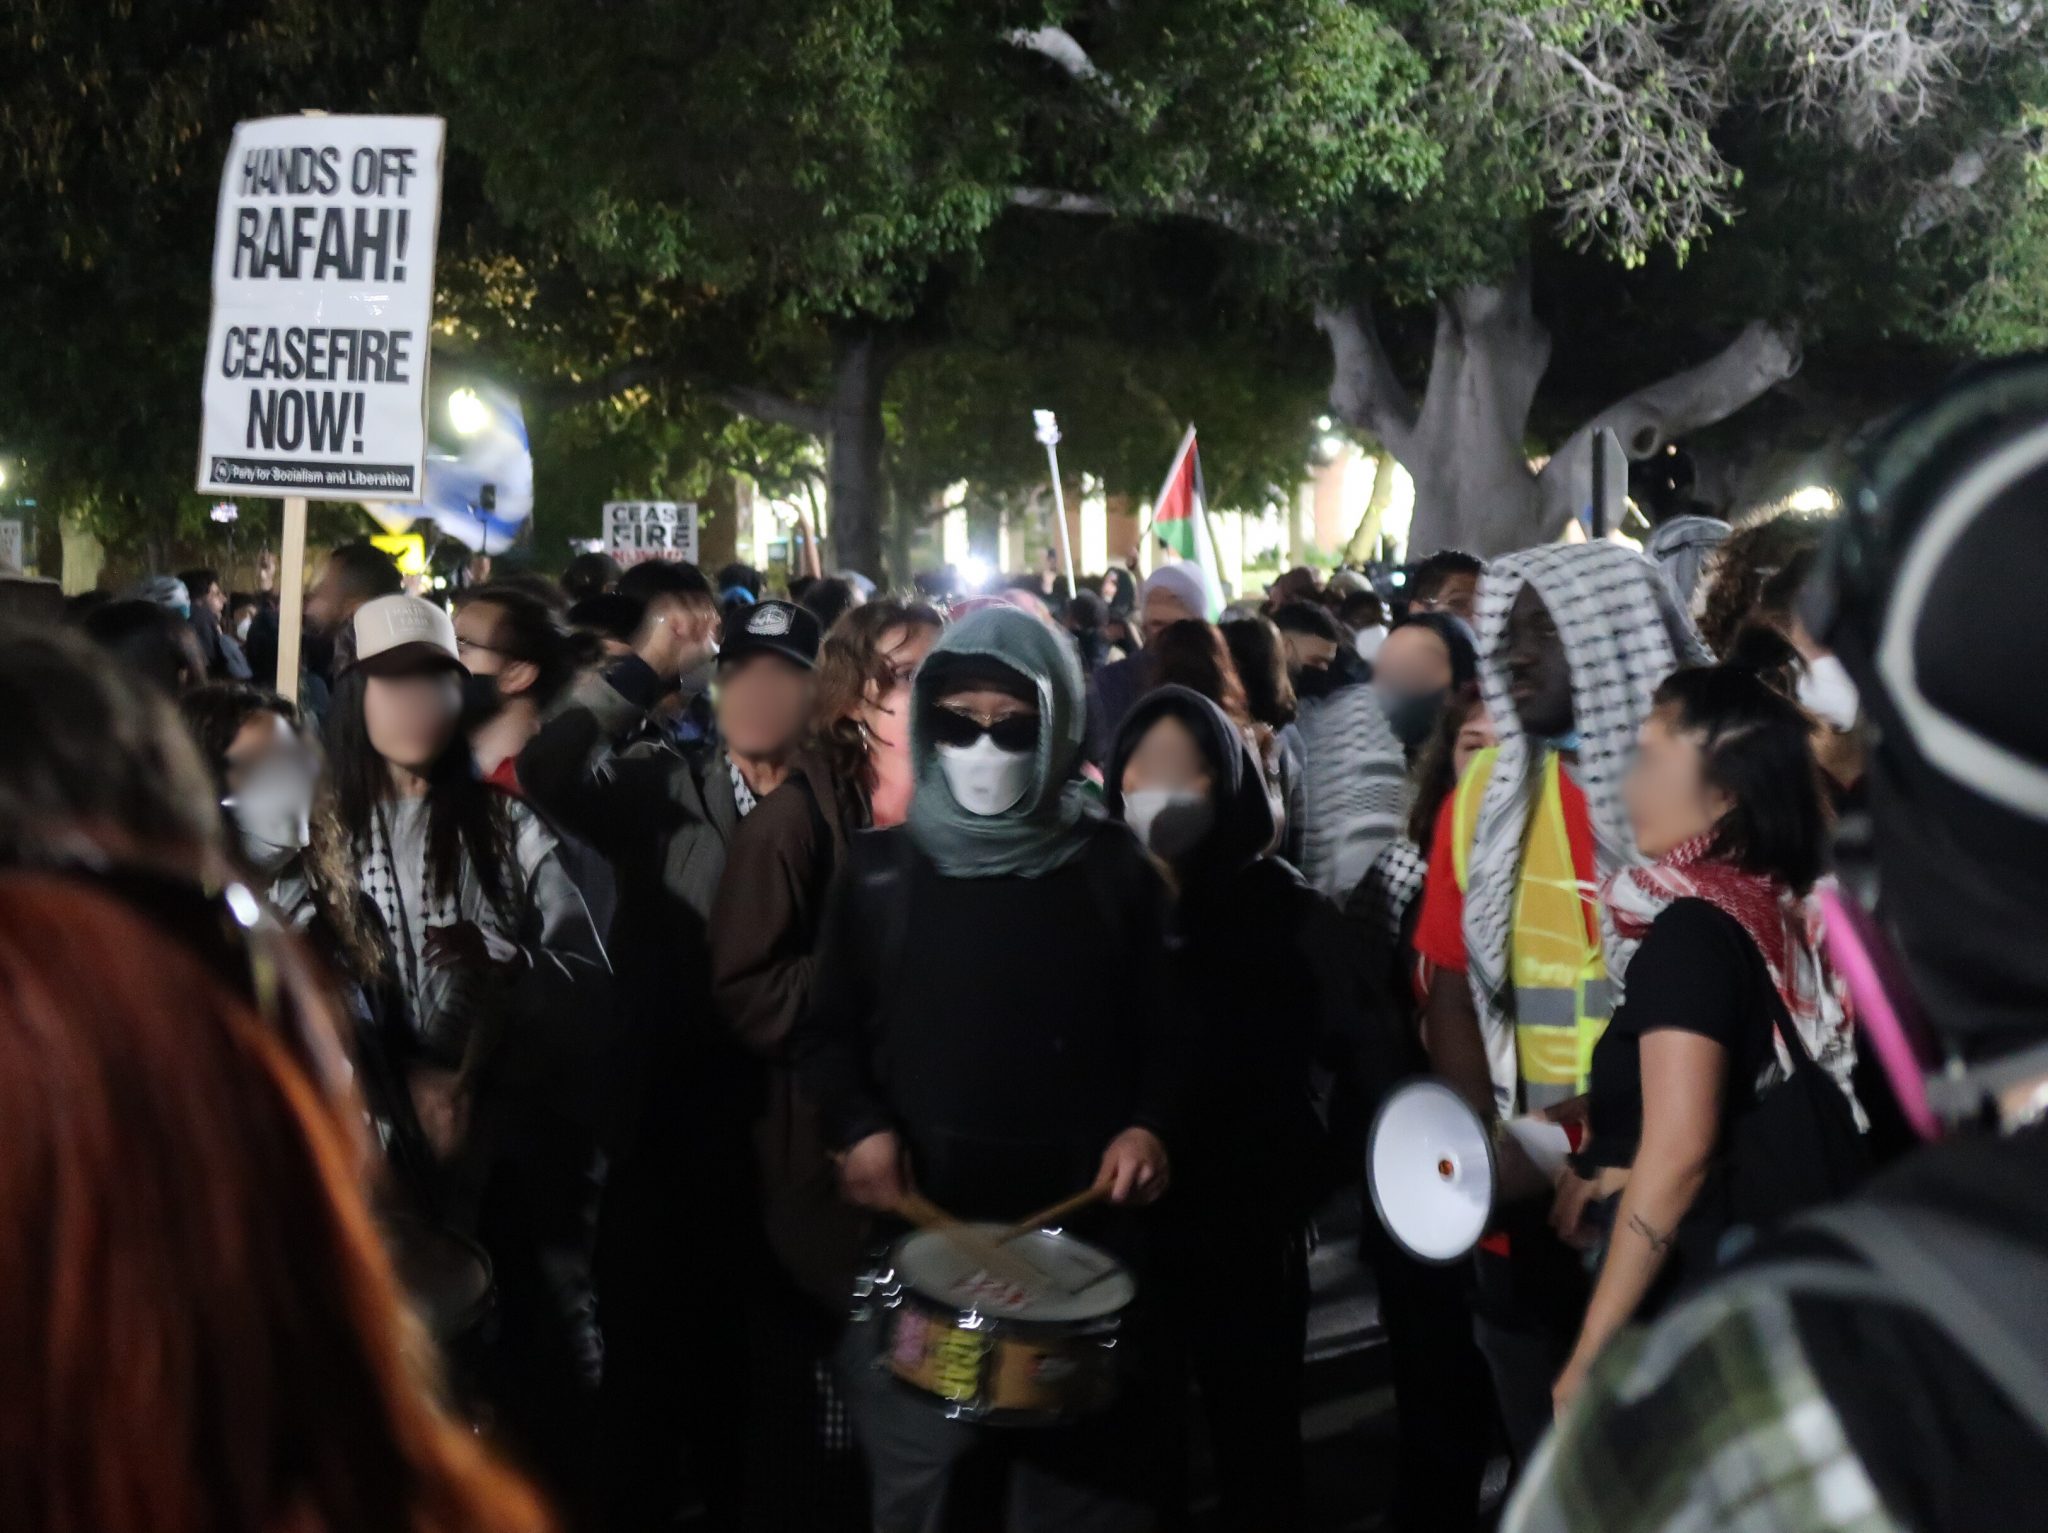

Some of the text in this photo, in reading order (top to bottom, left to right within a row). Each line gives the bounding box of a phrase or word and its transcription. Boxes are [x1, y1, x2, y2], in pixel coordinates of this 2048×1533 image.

[241, 146, 417, 197] HANDS OFF
[232, 206, 411, 282] RAFAH!
[222, 326, 412, 384] CEASEFIRE
[246, 388, 367, 454] NOW!
[233, 463, 410, 487] Party for Socialism and Liberation
[612, 506, 690, 522] CEASE
[612, 524, 690, 547] FIRE
